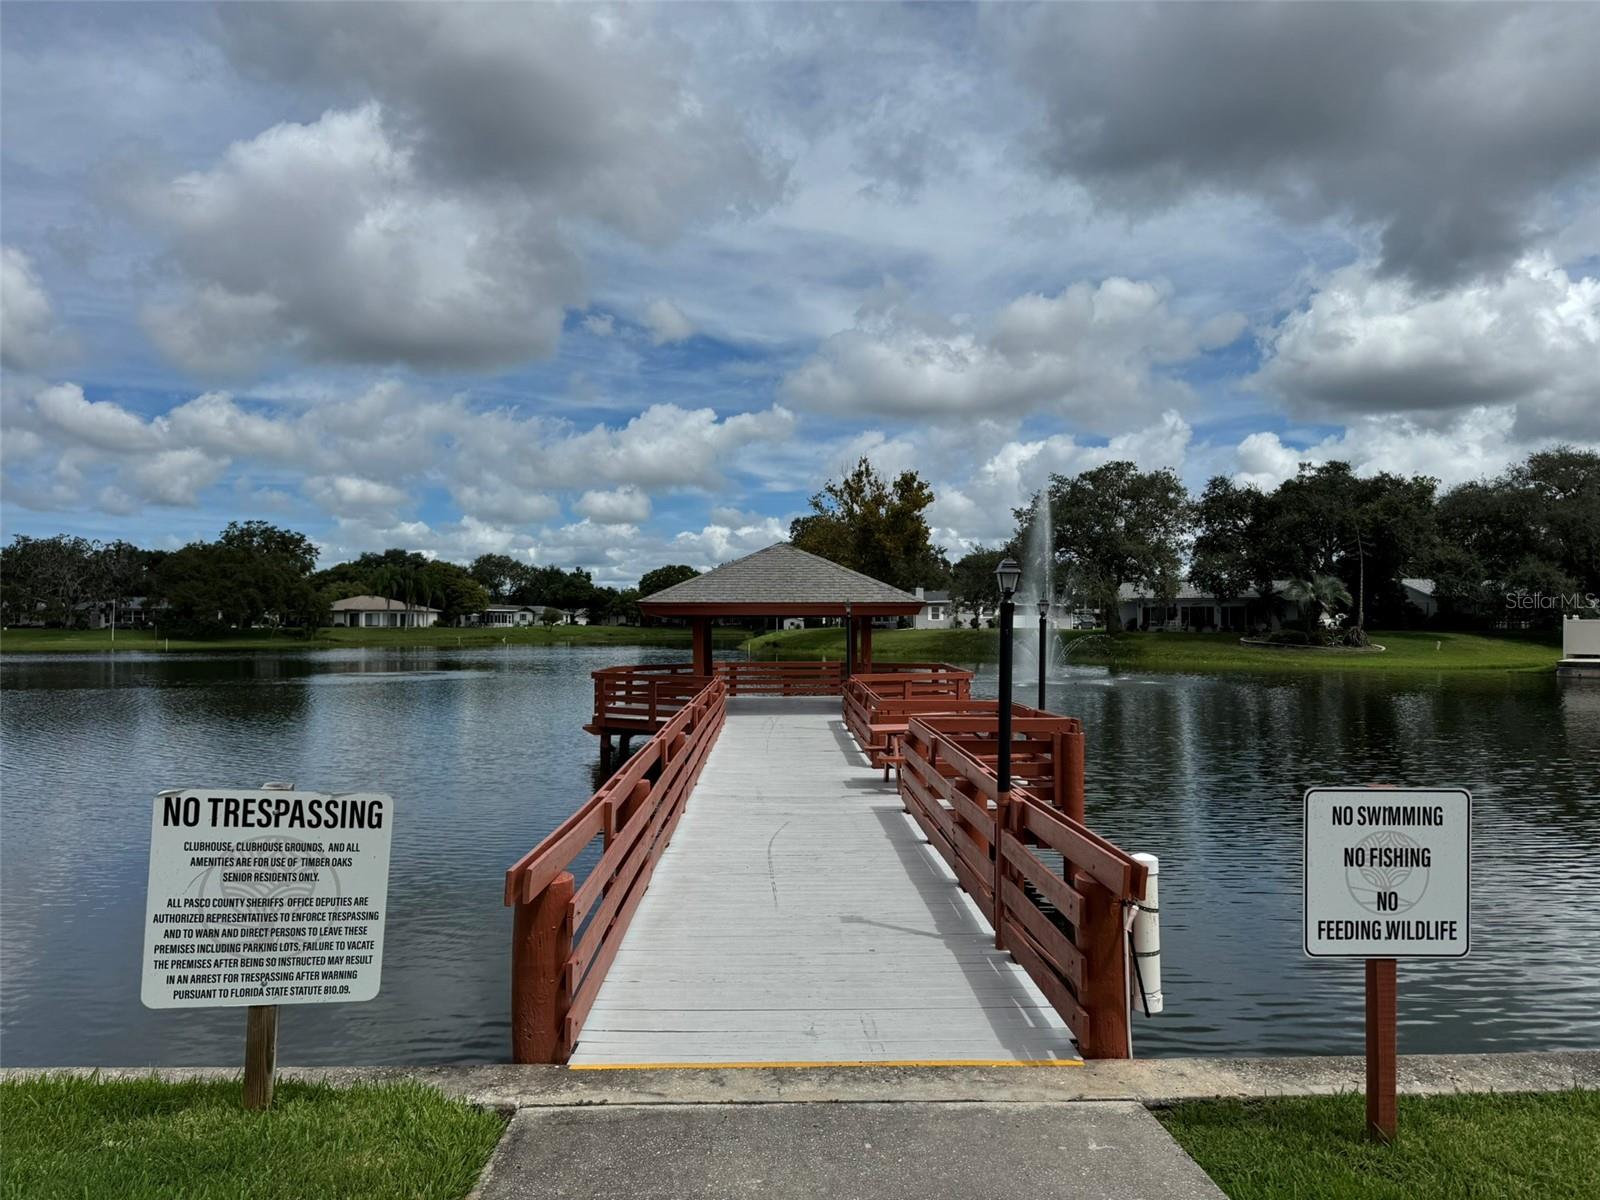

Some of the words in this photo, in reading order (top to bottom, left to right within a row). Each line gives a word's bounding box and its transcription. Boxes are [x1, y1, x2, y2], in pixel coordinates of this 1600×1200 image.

[163, 797, 200, 827] NO
[208, 798, 383, 828] TRESPASSING
[1332, 806, 1353, 826] NO
[1357, 806, 1443, 826] SWIMMING
[236, 842, 283, 852] CLUBHOUSE
[328, 843, 345, 852] AND
[346, 843, 360, 852] ALL
[190, 857, 234, 867] AMENITIES
[236, 857, 252, 867] ARE
[253, 857, 269, 867] FOR
[270, 858, 286, 867] USE
[288, 858, 298, 867] OF
[301, 858, 330, 867] TIMBER
[331, 858, 352, 867] OAKS
[1344, 848, 1365, 867] NO
[1370, 848, 1431, 867] FISHING
[223, 873, 252, 882] SENIOR
[254, 873, 297, 882] RESIDENTS
[299, 873, 319, 882] ONLY.
[167, 898, 182, 908] ALL
[184, 898, 211, 908] PASCO
[212, 898, 245, 908] COUNTY
[246, 898, 284, 907] SHERIFFS
[287, 898, 314, 907] OFFICE
[316, 897, 352, 907] DEPUTIES
[353, 897, 369, 906] ARE
[1377, 892, 1398, 911] NO
[153, 914, 204, 923] AUTHORIZED
[206, 913, 278, 923] REPRESENTATIVES
[280, 913, 290, 922] TO
[292, 912, 326, 922] ENFORCE
[328, 911, 379, 921] TRESPASSING
[164, 929, 181, 939] AND
[183, 929, 193, 938] TO
[195, 928, 220, 938] WARN
[221, 928, 239, 938] AND
[240, 928, 269, 938] DIRECT
[270, 927, 306, 937] PERSONS
[308, 927, 318, 936] TO
[319, 926, 343, 936] LEAVE
[344, 926, 368, 936] THESE
[1318, 920, 1381, 940] FEEDING
[1386, 921, 1457, 940] WILDLIFE
[154, 944, 195, 954] PREMISES
[197, 943, 241, 953] INCLUDING
[242, 943, 278, 952] PARKING
[302, 942, 334, 952] FAILURE
[336, 941, 346, 951] TO
[347, 941, 374, 950] VACATE
[154, 959, 169, 969] THE
[170, 958, 212, 969] PREMISES
[213, 958, 238, 968] AFTER
[240, 957, 264, 968] BEING
[265, 957, 276, 967] SO
[278, 956, 326, 967] INSTRUCTED
[327, 956, 344, 965] MAY
[345, 955, 373, 965] RESULT
[166, 975, 175, 984] IN
[176, 974, 188, 984] AN
[190, 974, 222, 984] ARREST
[223, 973, 239, 983] FOR
[241, 972, 294, 982] TRESPASSING
[295, 971, 320, 981] AFTER
[321, 970, 357, 980] WARNING
[173, 989, 217, 1000] PURSUANT
[218, 989, 229, 998] TO
[230, 988, 264, 998] FLORIDA
[265, 987, 288, 997] STATE
[290, 986, 322, 996] STATUTE
[324, 985, 350, 995] 810.09.
